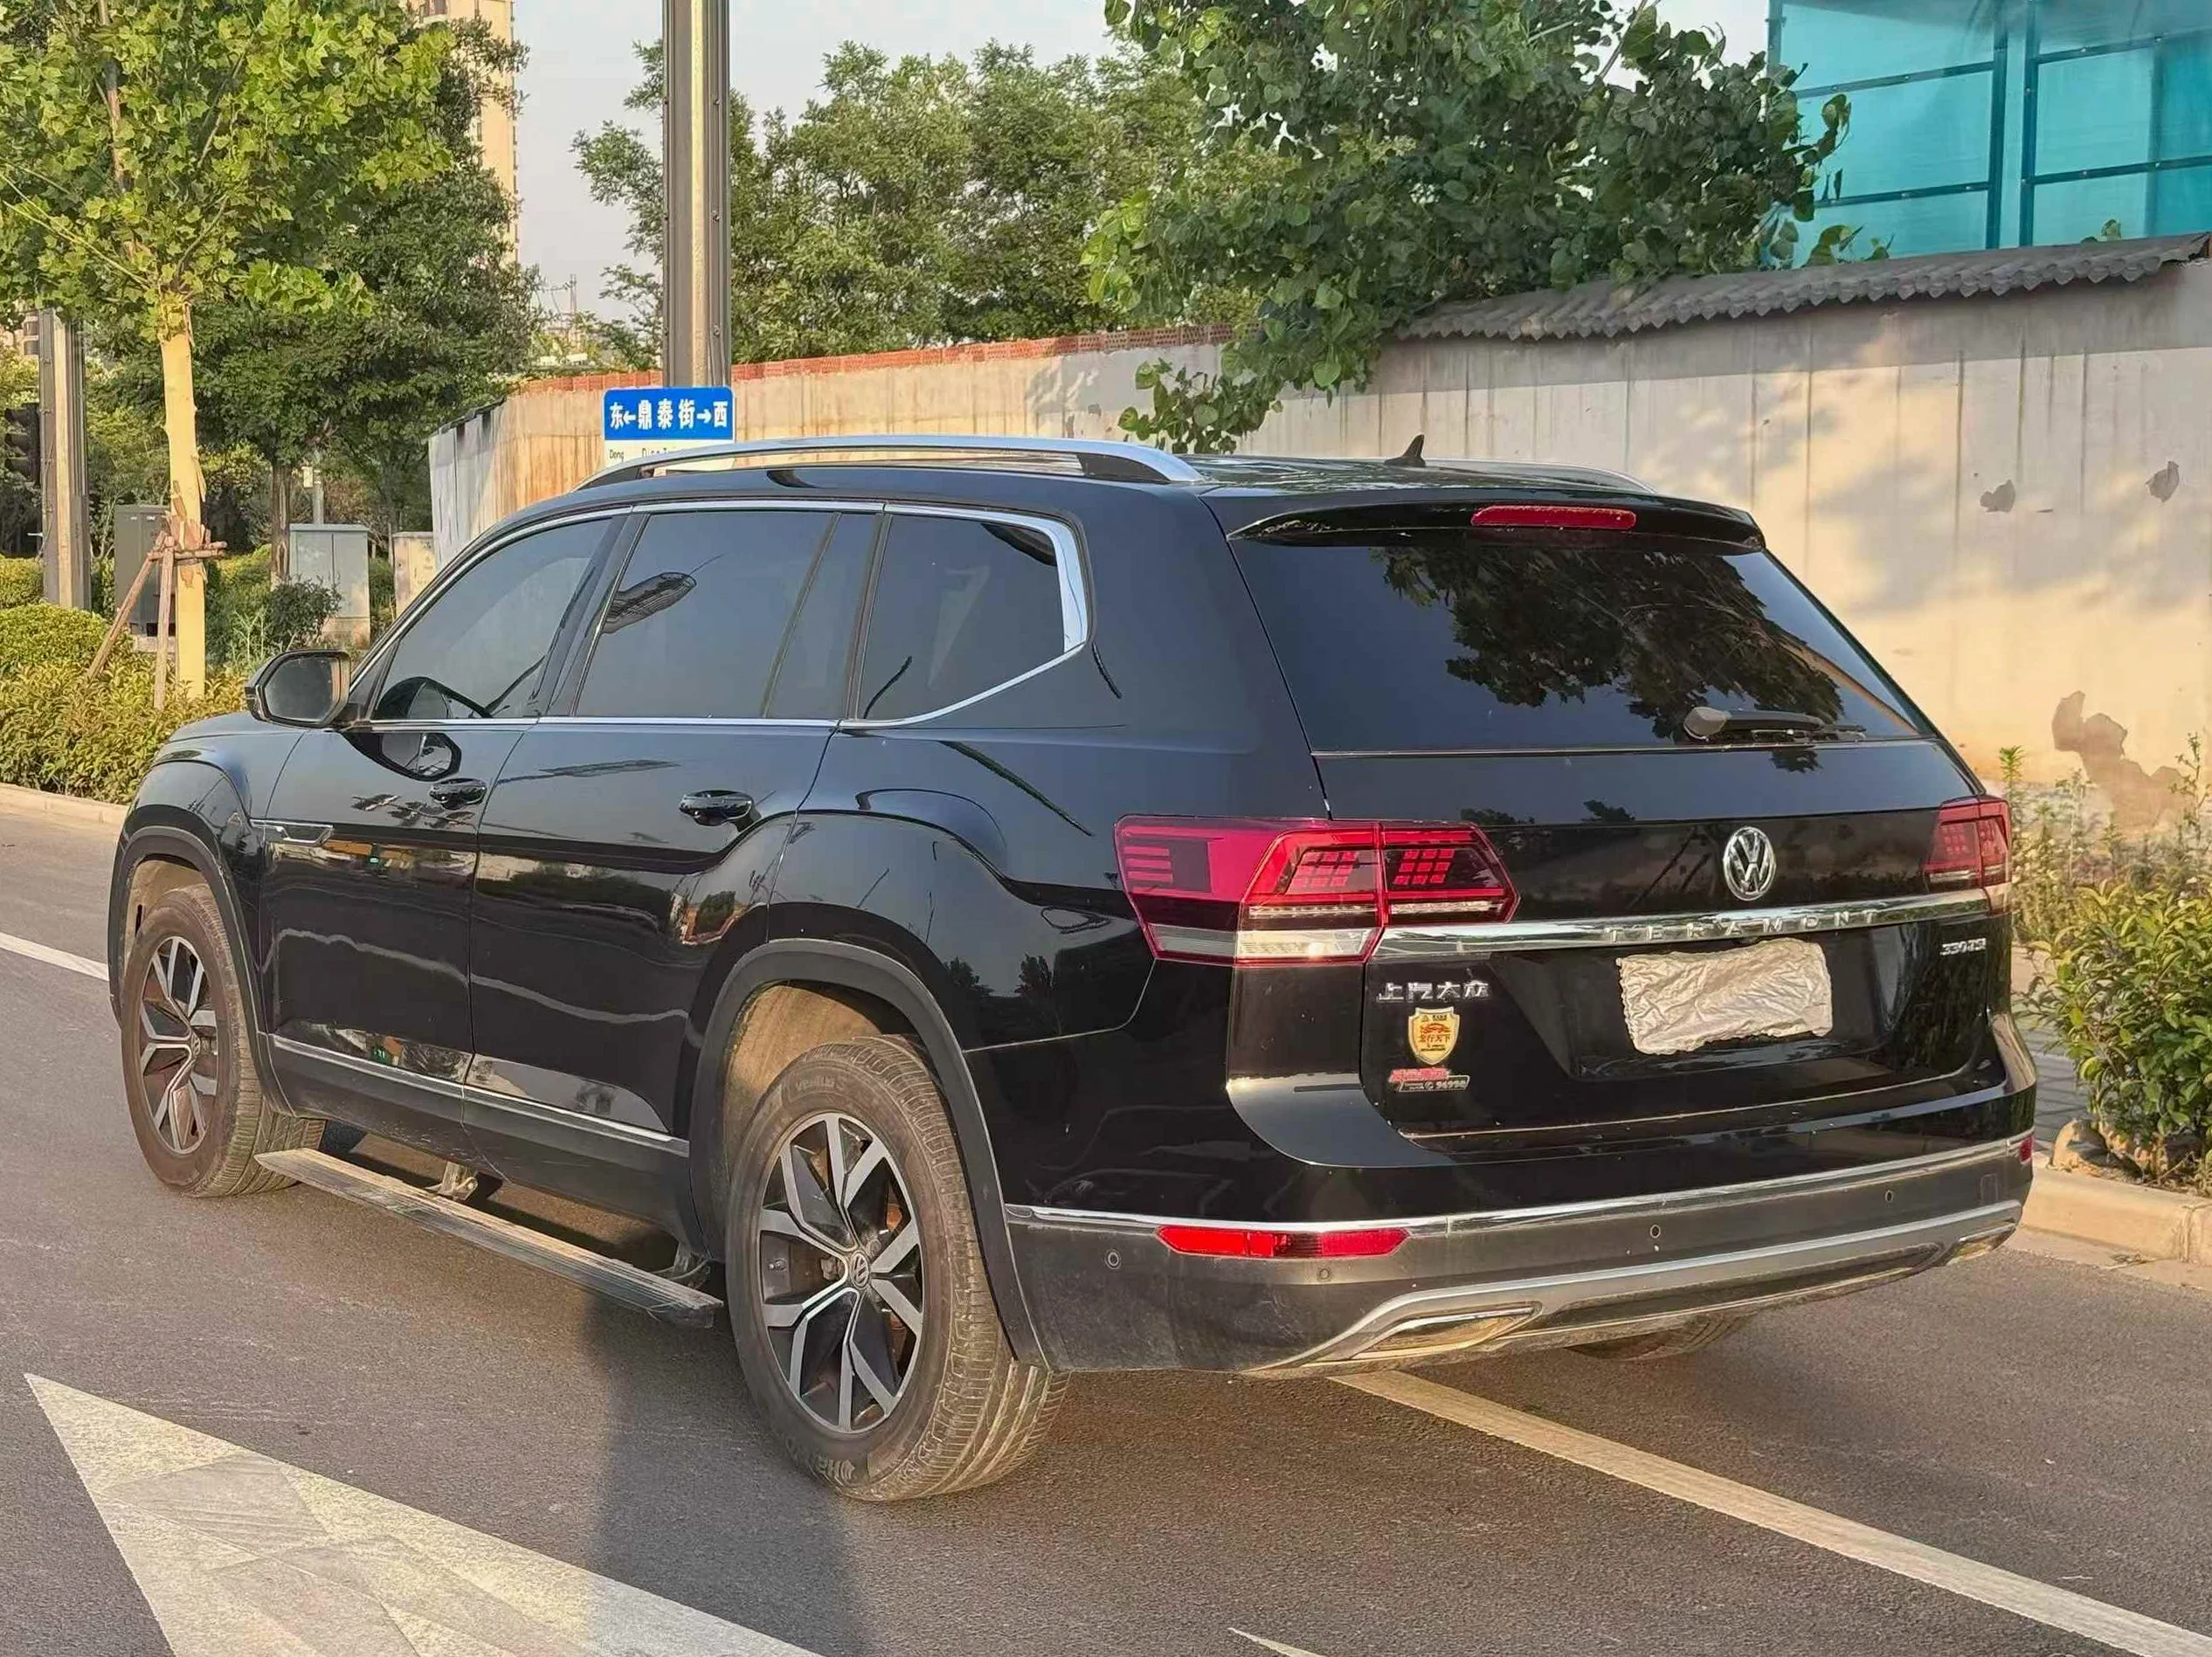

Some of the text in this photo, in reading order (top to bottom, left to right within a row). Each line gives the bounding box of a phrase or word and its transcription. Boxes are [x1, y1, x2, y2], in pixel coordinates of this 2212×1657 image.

[610, 398, 729, 430] 东 鼎泰街 西
[1604, 910, 1879, 942] TERAMONT
[1378, 979, 1490, 1002] 上汽大众
